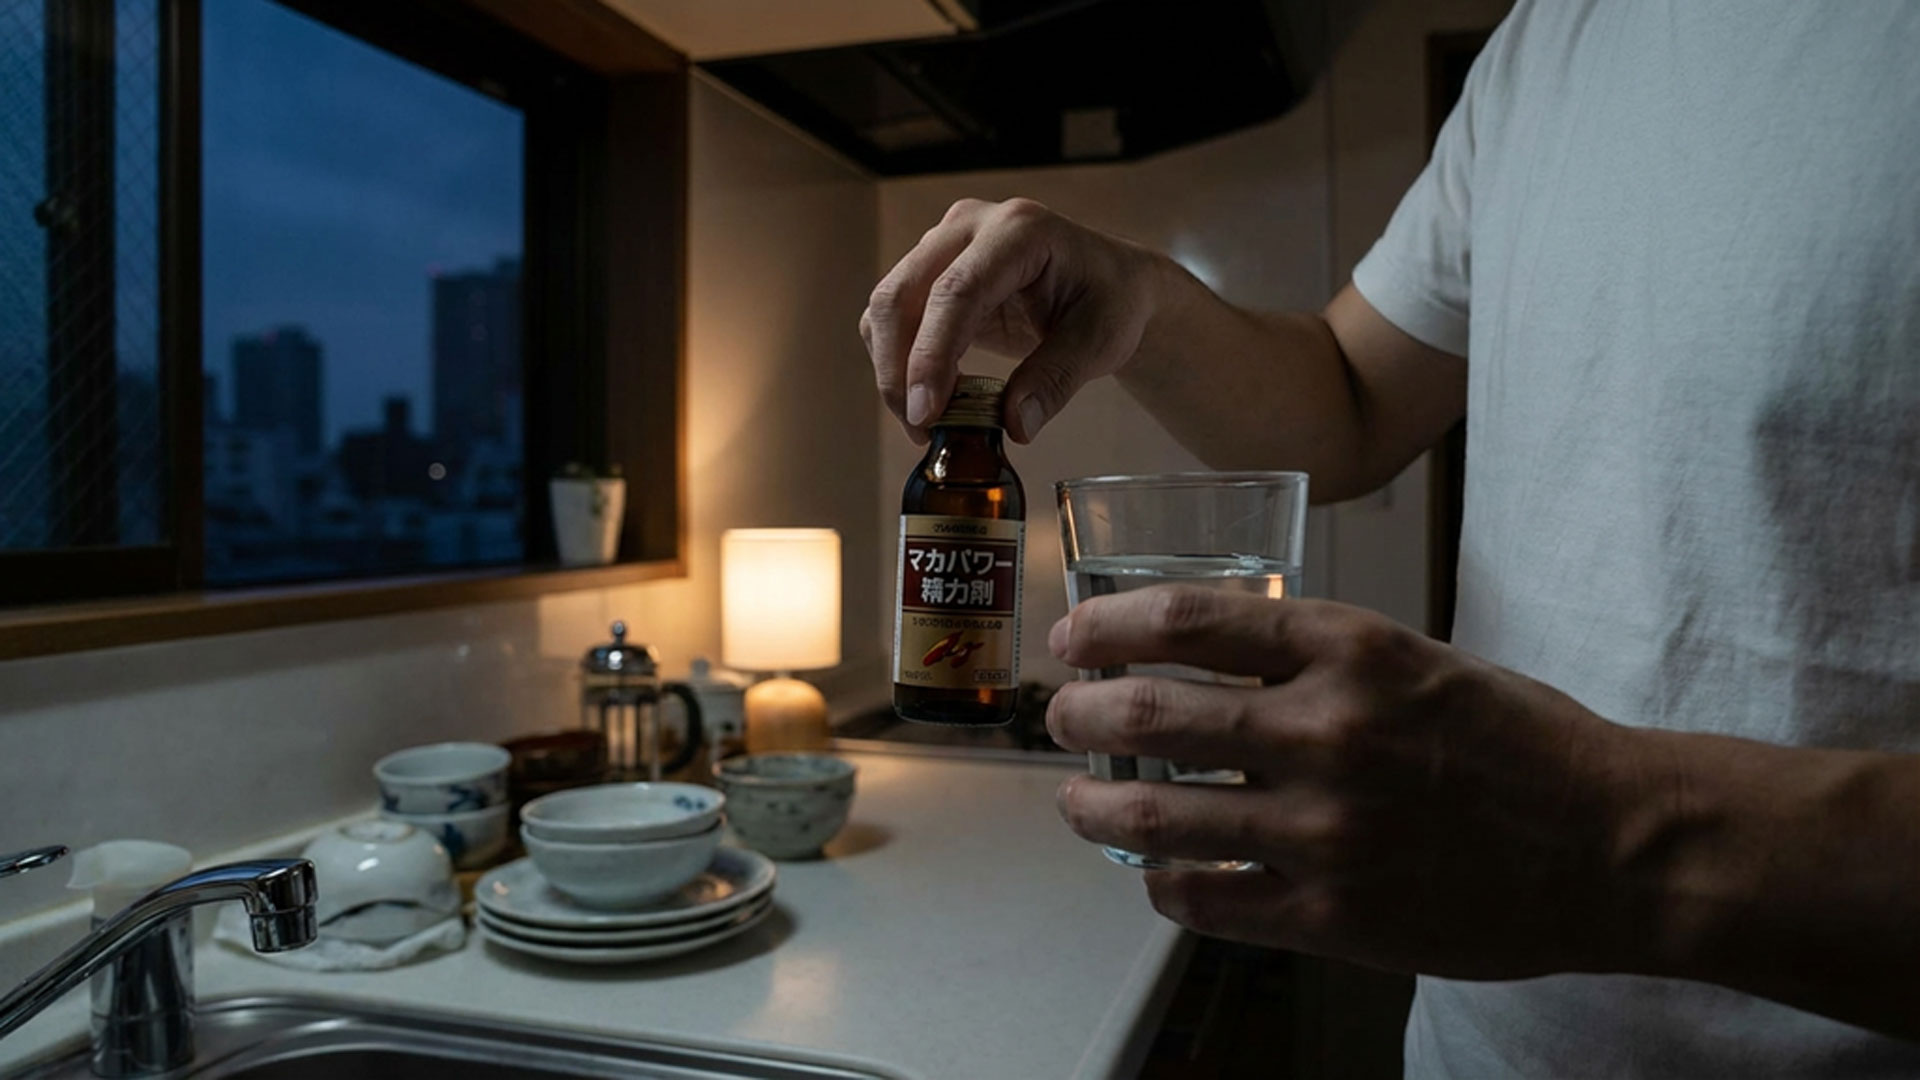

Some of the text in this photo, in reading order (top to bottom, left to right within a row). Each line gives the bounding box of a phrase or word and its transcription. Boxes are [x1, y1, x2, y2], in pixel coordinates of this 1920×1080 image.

[908, 548, 1013, 575] マカパワー
